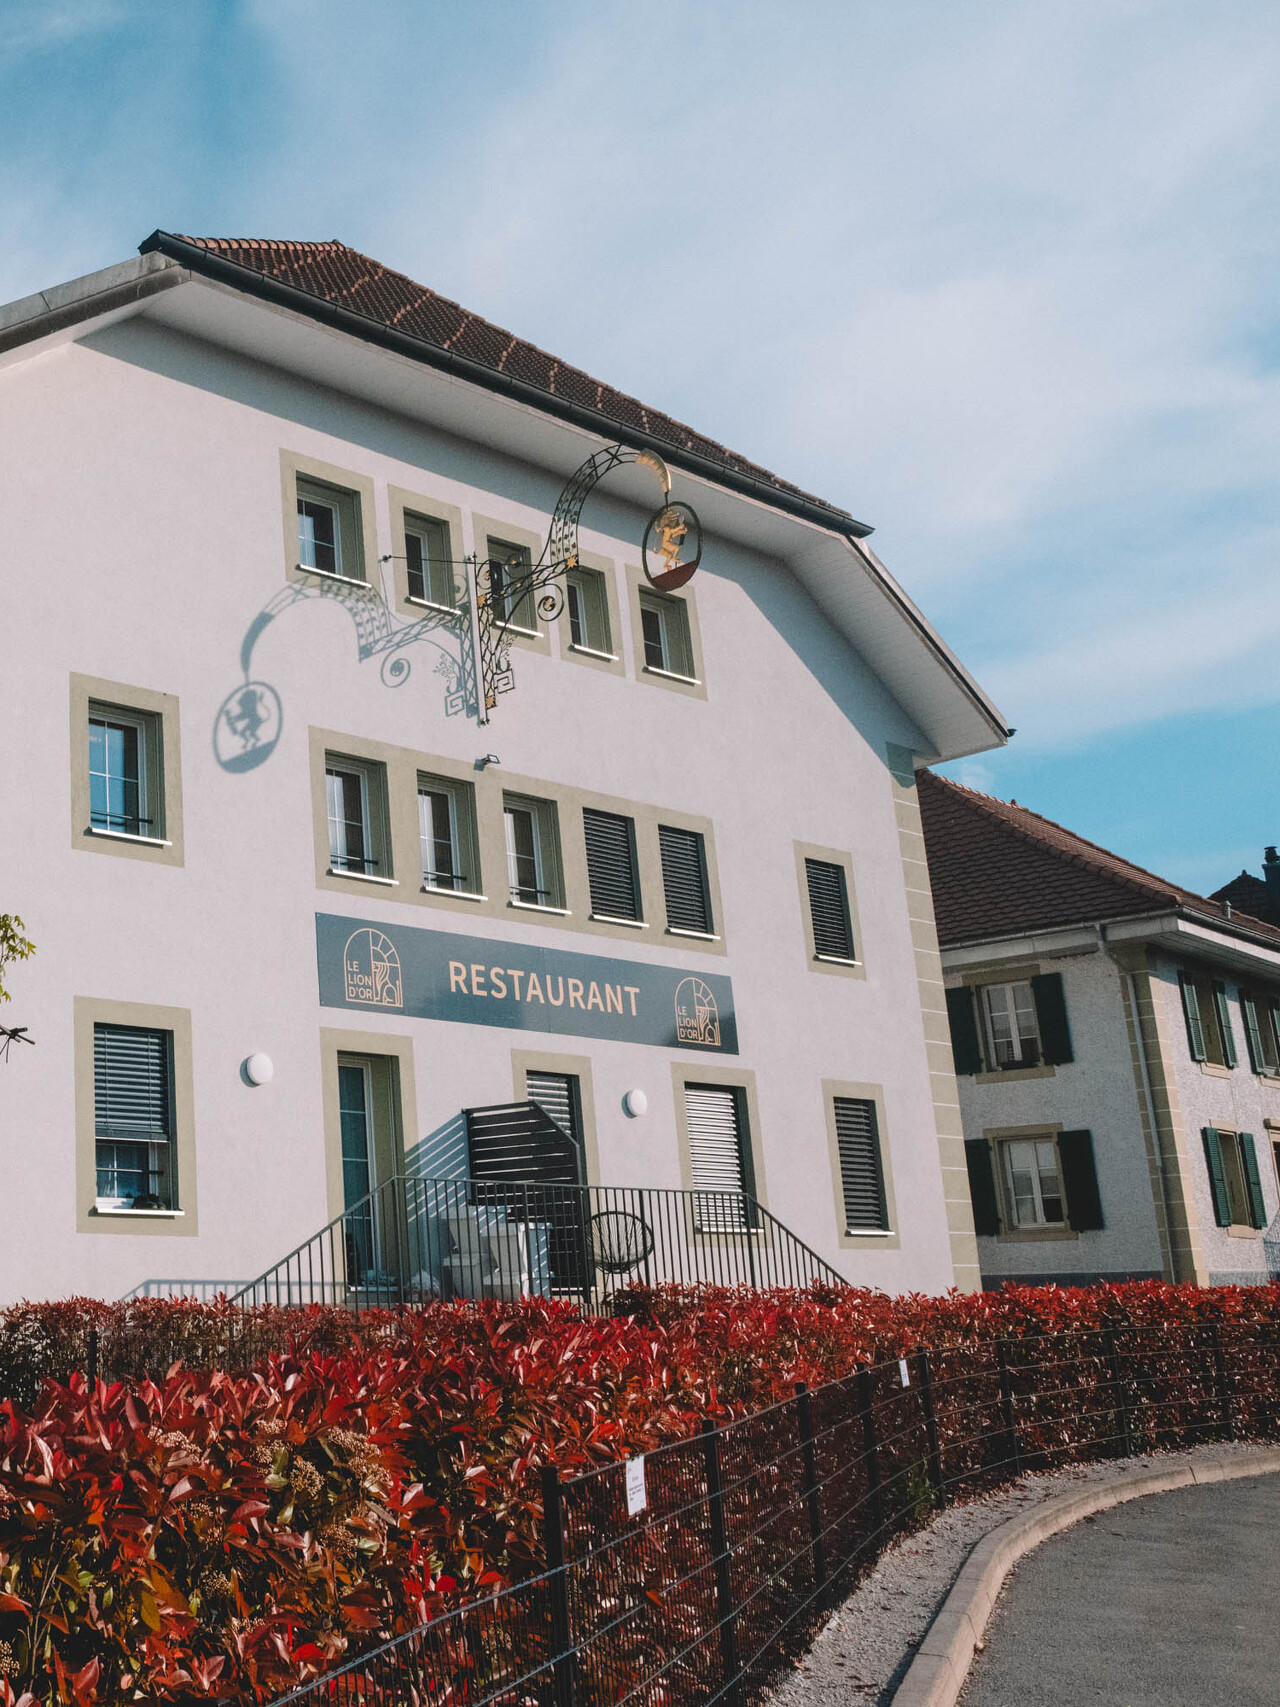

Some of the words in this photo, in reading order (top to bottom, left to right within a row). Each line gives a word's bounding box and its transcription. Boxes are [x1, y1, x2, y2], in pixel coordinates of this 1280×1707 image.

[347, 960, 359, 972] LE
[348, 973, 372, 986] LION
[349, 986, 373, 1000] D'OR
[448, 961, 640, 1016] RESTAURANT
[678, 1005, 687, 1016] LE
[679, 1017, 697, 1028] LION
[680, 1028, 698, 1040] D'OR
